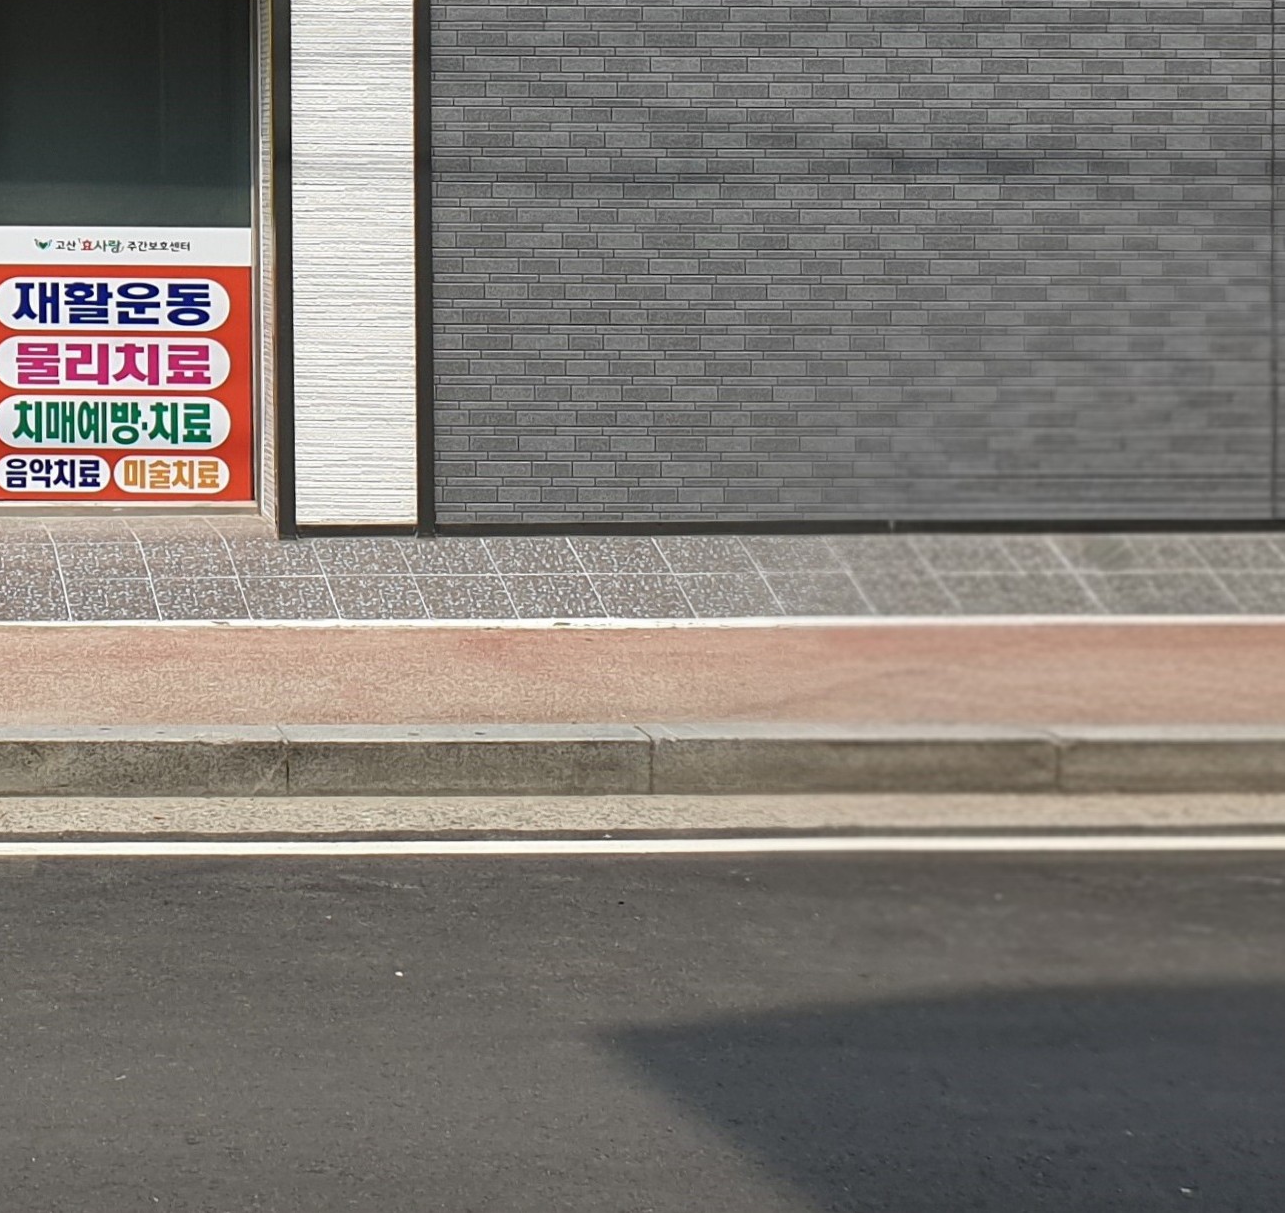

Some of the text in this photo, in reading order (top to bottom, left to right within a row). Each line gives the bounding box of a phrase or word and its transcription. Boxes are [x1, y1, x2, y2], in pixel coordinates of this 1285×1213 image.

[55, 238, 191, 253] 고산 효사랑 주간보호센터
[12, 282, 211, 326] 재활운동
[15, 342, 211, 385] 물리치료
[5, 458, 220, 490] 음악치료 미술치료
